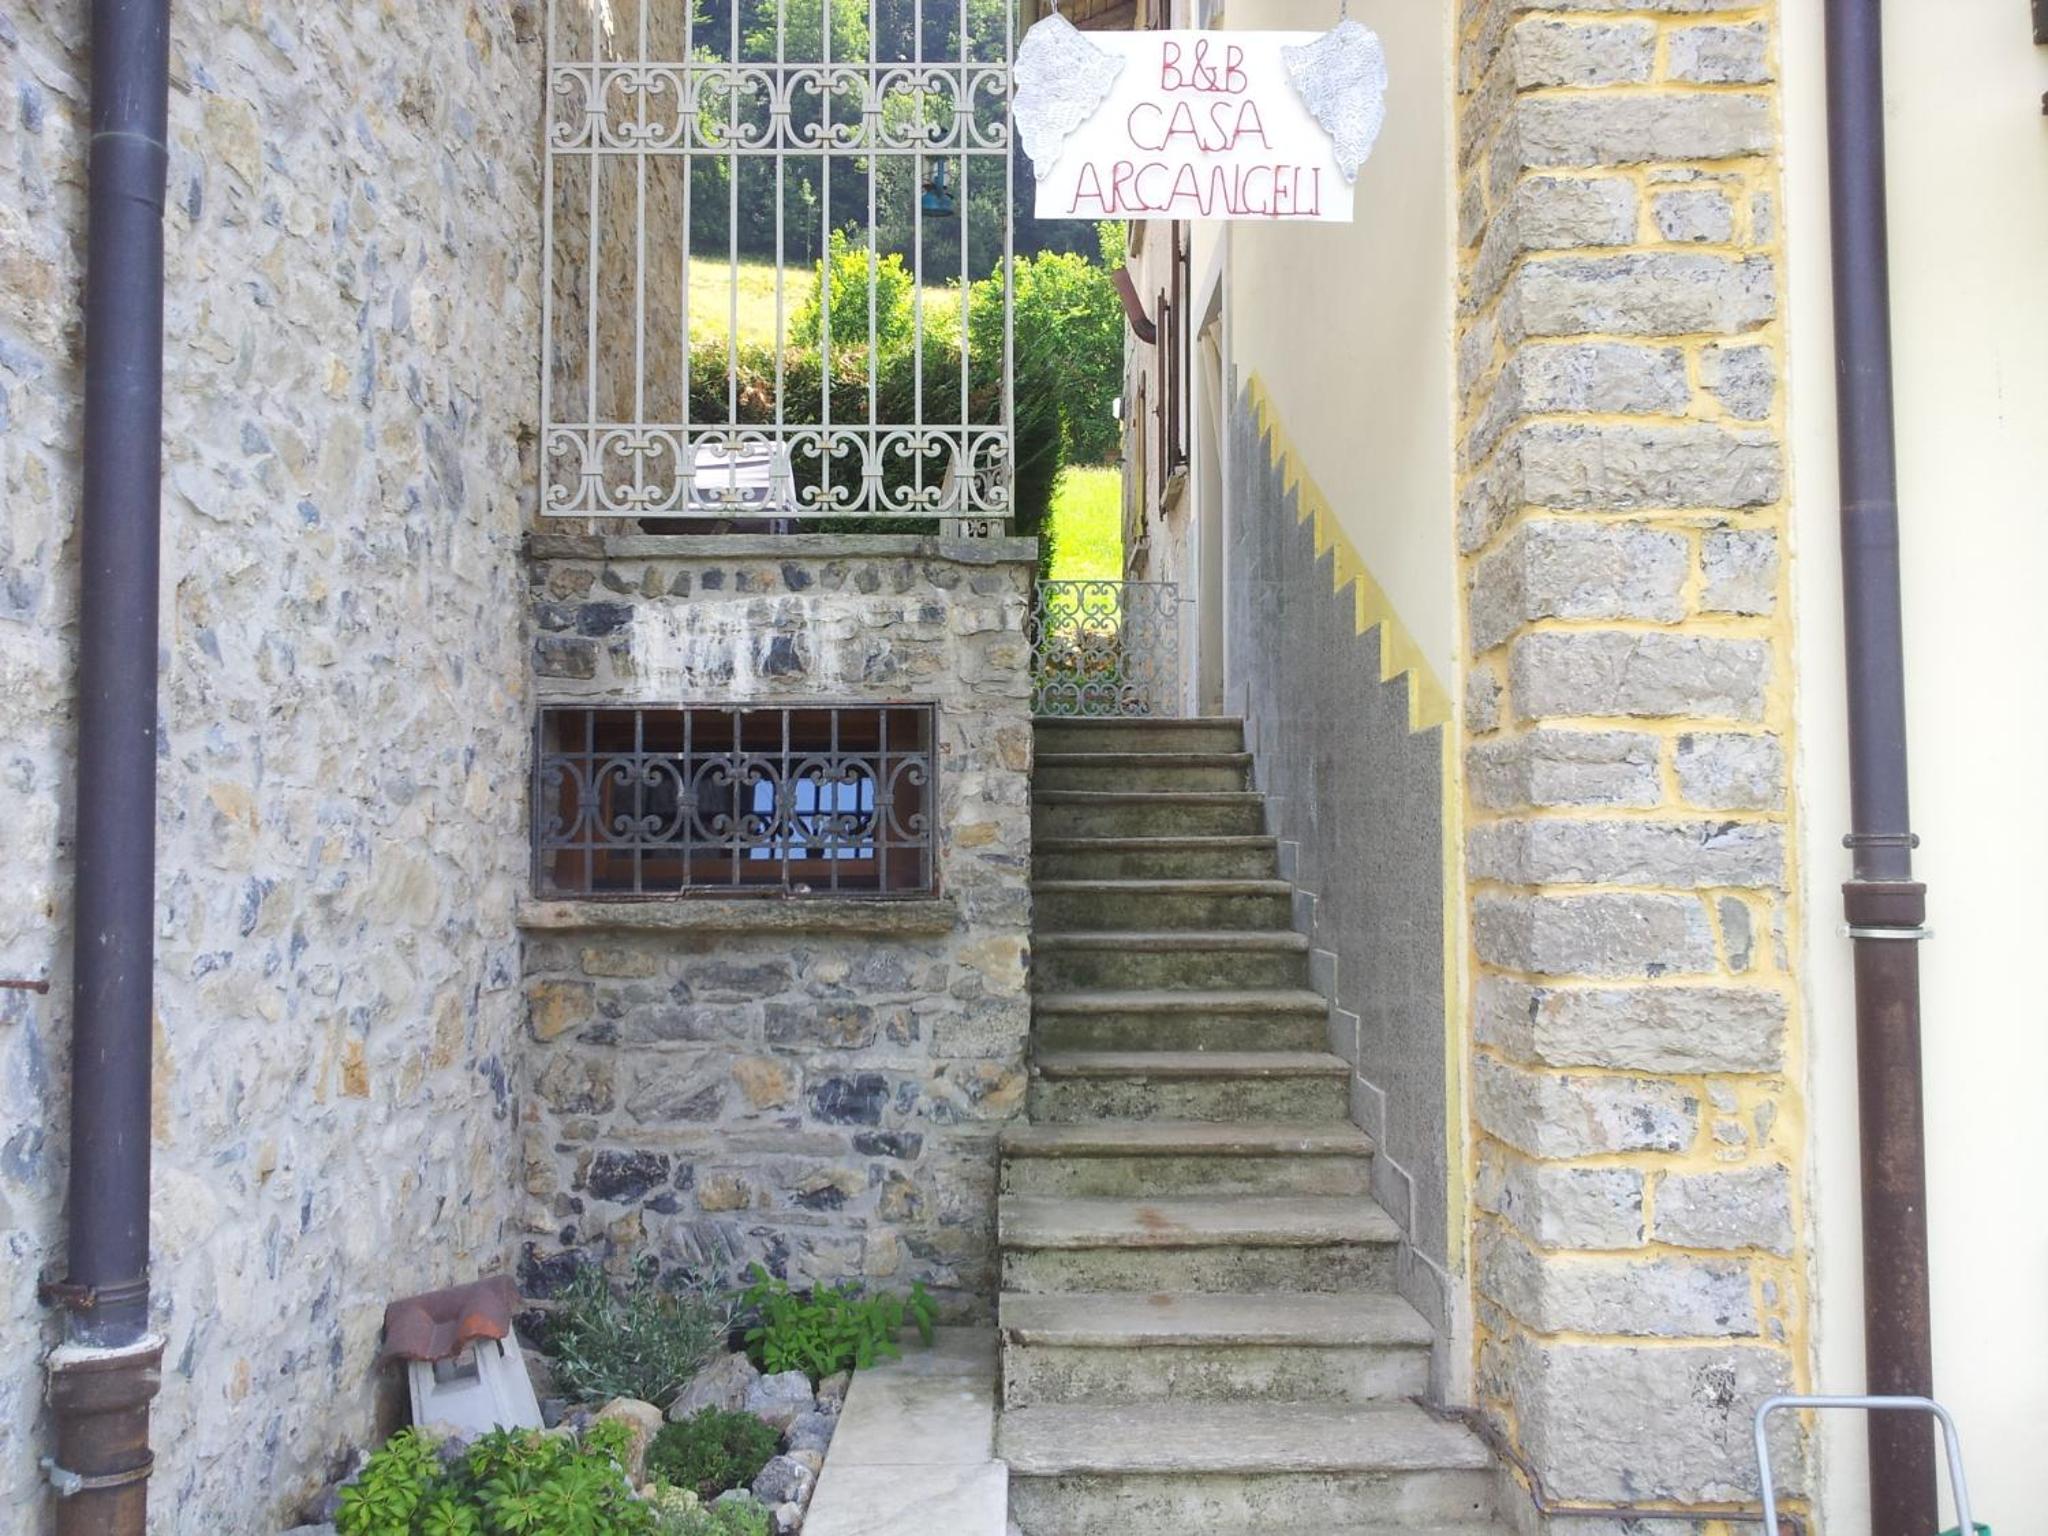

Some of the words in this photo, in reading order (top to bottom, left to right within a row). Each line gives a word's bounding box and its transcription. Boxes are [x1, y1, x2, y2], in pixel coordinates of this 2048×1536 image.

[1161, 39, 1248, 95] B&B
[1127, 100, 1273, 152] CASA
[1067, 161, 1321, 217] ARCANGELI
